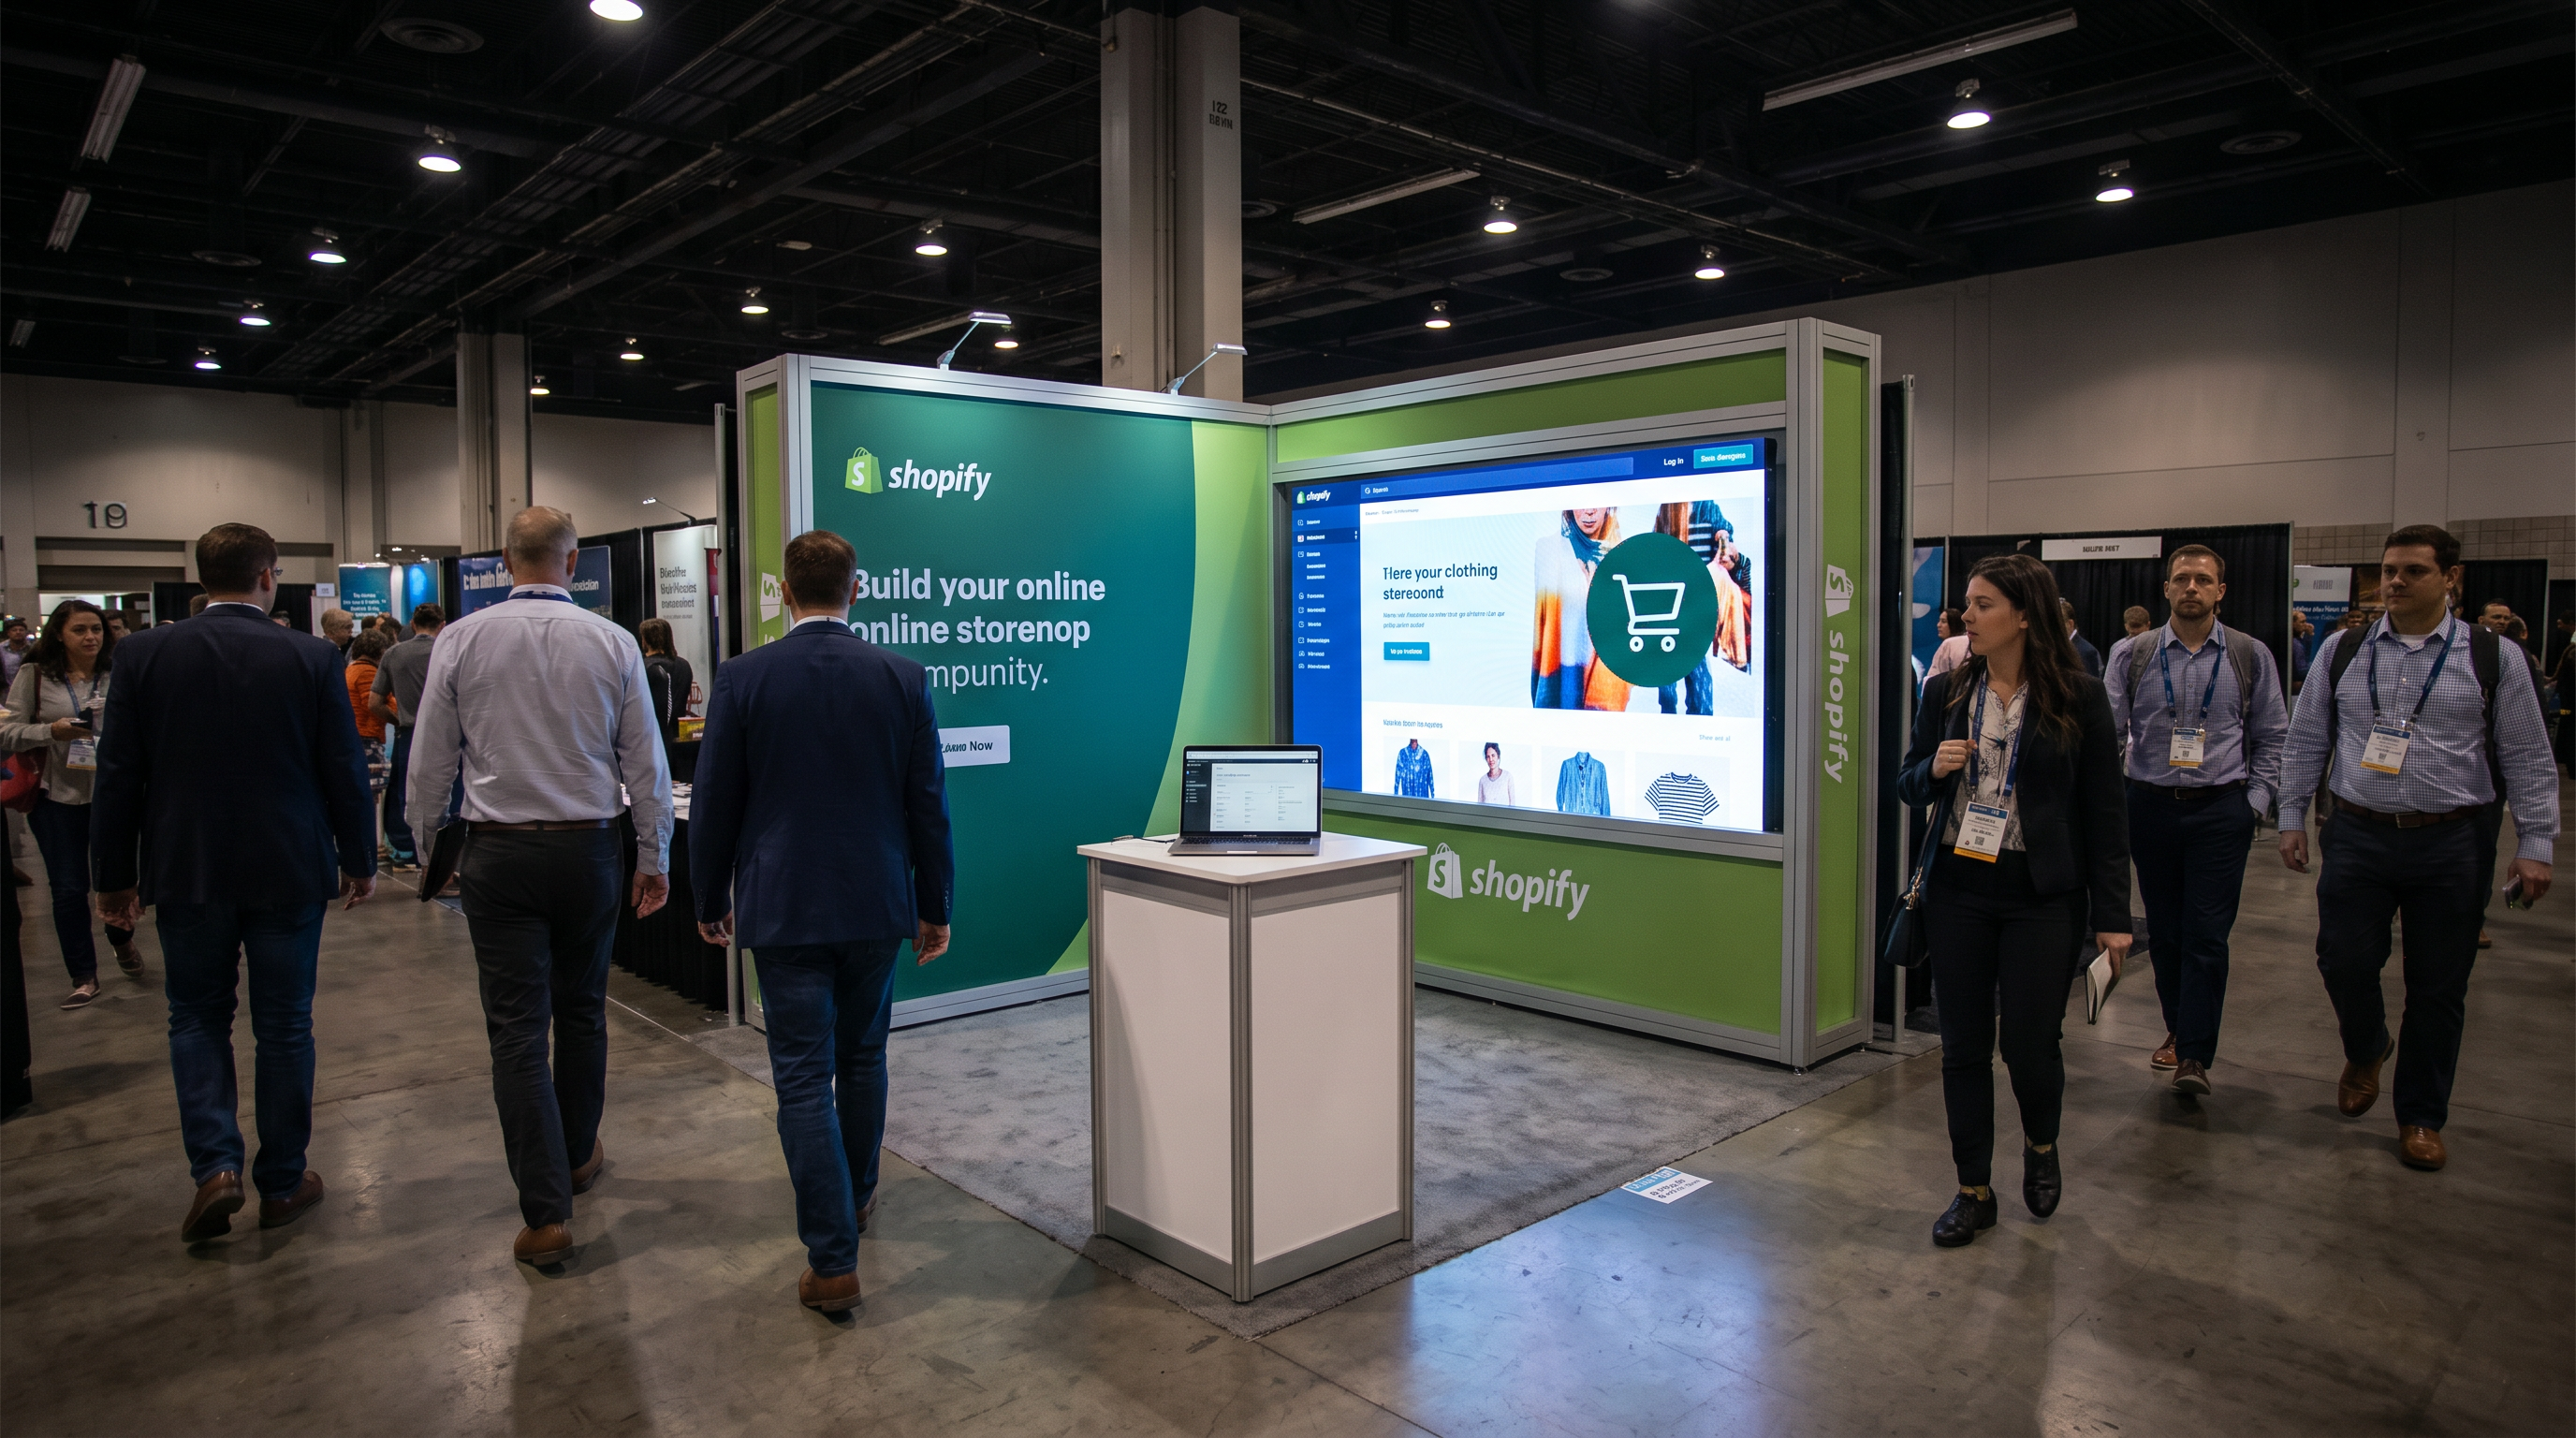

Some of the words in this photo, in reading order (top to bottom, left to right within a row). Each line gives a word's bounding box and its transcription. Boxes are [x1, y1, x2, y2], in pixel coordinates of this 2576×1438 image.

[888, 459, 992, 501] shopify
[1663, 458, 1676, 466] Log
[856, 567, 931, 600] Build
[939, 577, 1010, 607] your
[1016, 570, 1105, 601] online
[1414, 567, 1442, 582] your
[1444, 563, 1498, 580] clothing
[849, 612, 949, 644] online
[956, 615, 1090, 649] storenop
[925, 656, 1048, 695] mpunity.
[1824, 629, 1850, 784] shopify
[970, 741, 993, 752] Now
[1469, 858, 1590, 921] shopify
